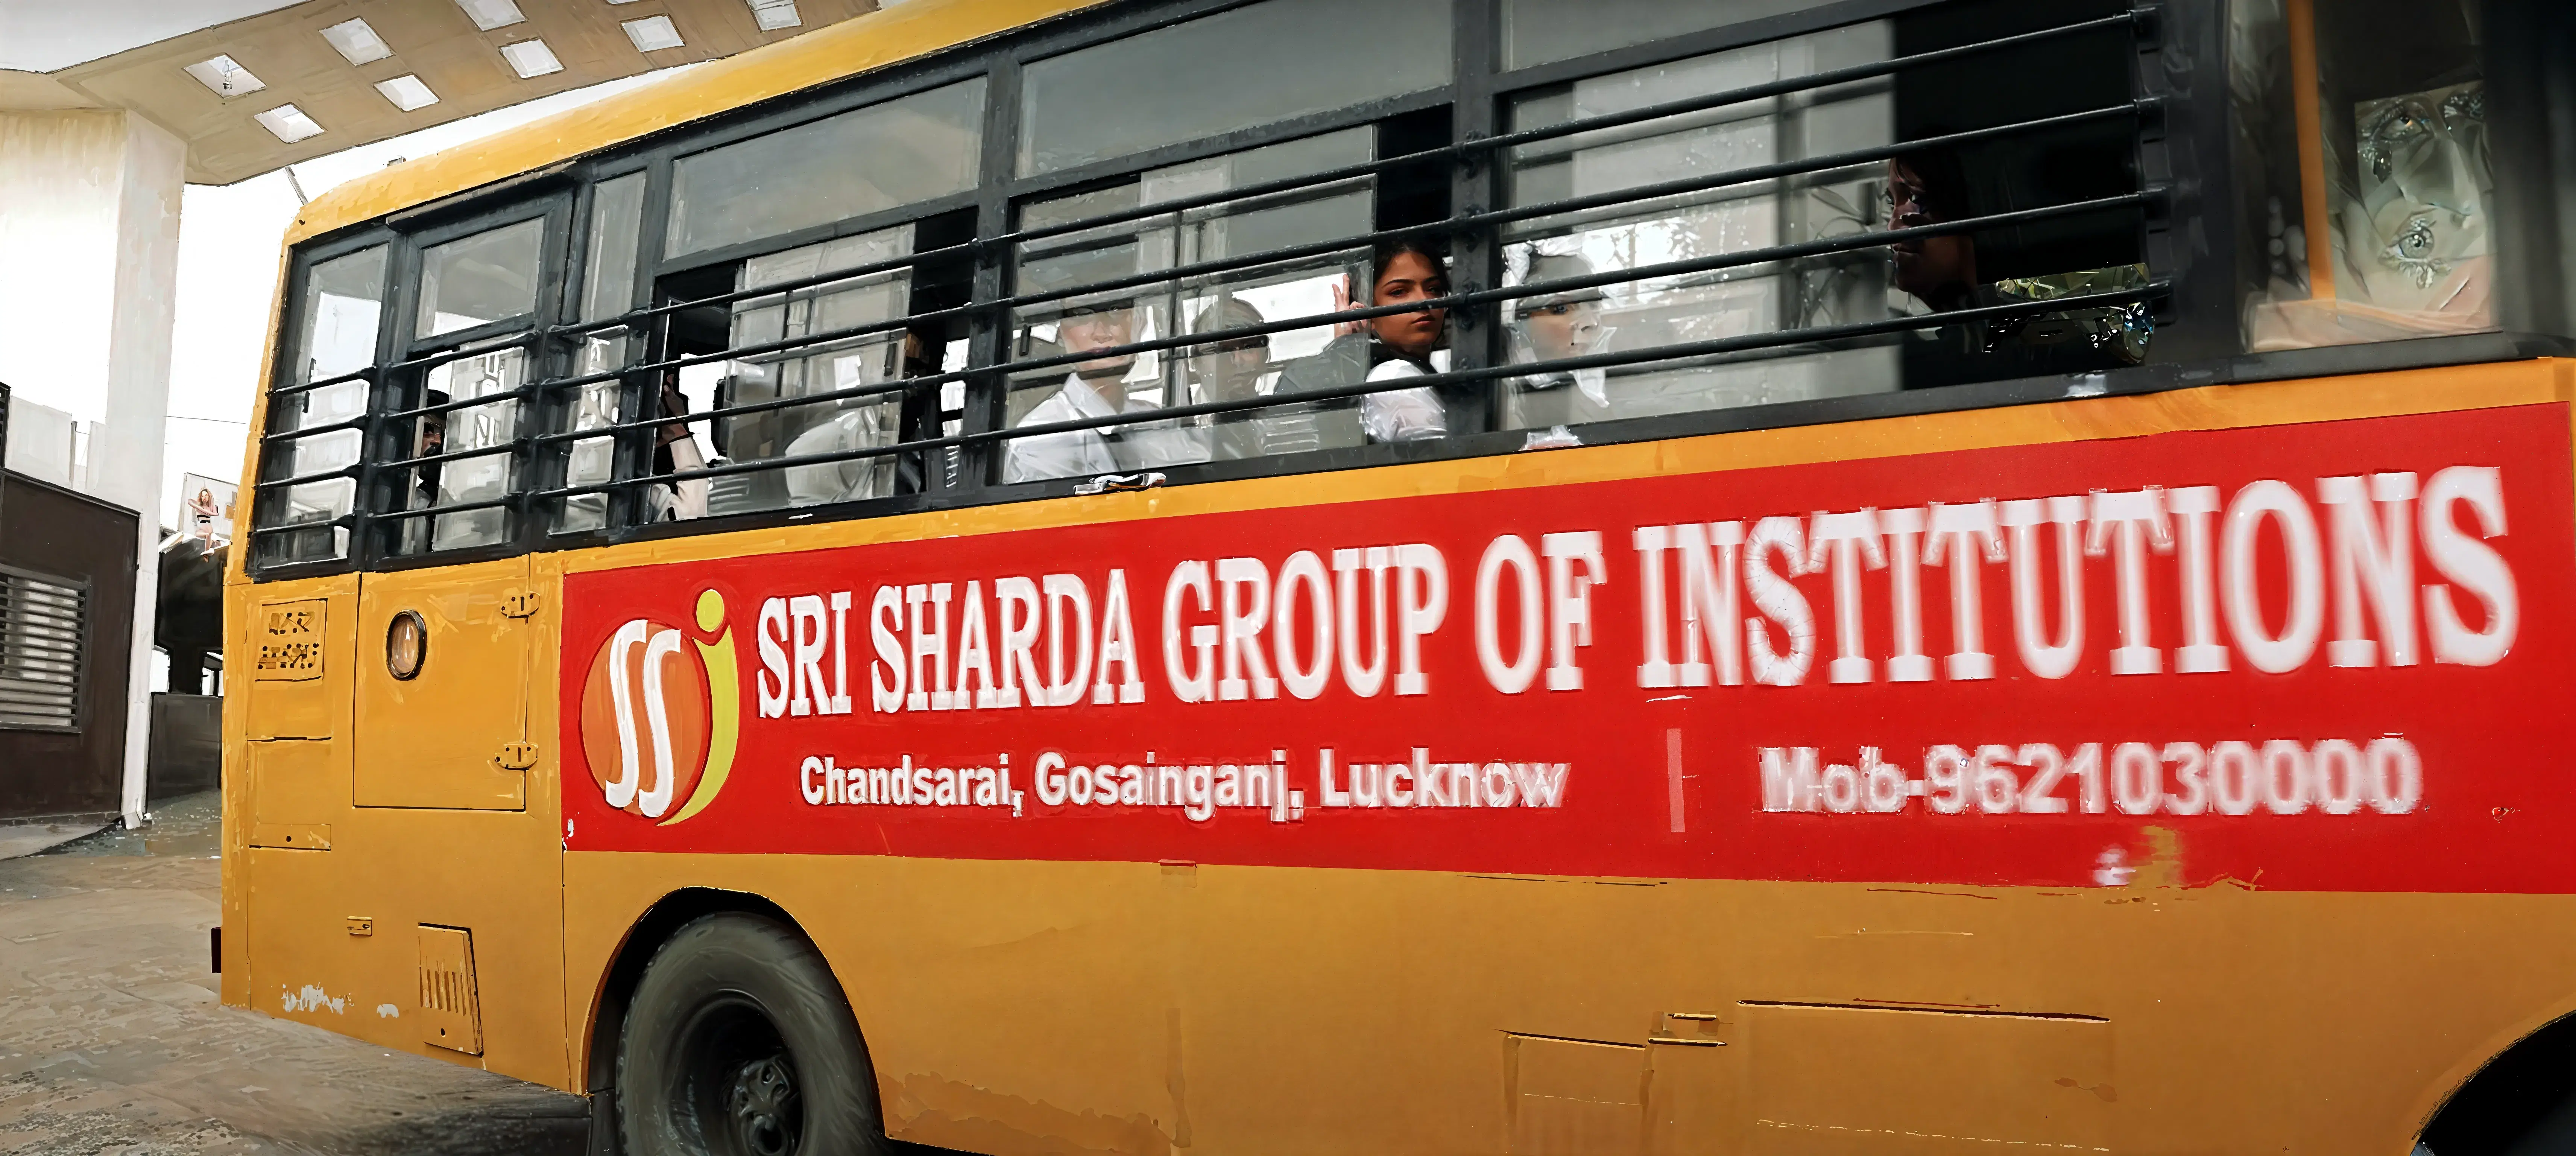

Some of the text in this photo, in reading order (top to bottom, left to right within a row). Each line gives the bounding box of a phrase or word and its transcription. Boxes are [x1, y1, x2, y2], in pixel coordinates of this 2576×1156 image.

[757, 465, 2520, 719] SRI SHARDA GROUP OF INSTITUTIONS
[800, 746, 1571, 823] Chandsarai, Gosainganj, Lucknow
